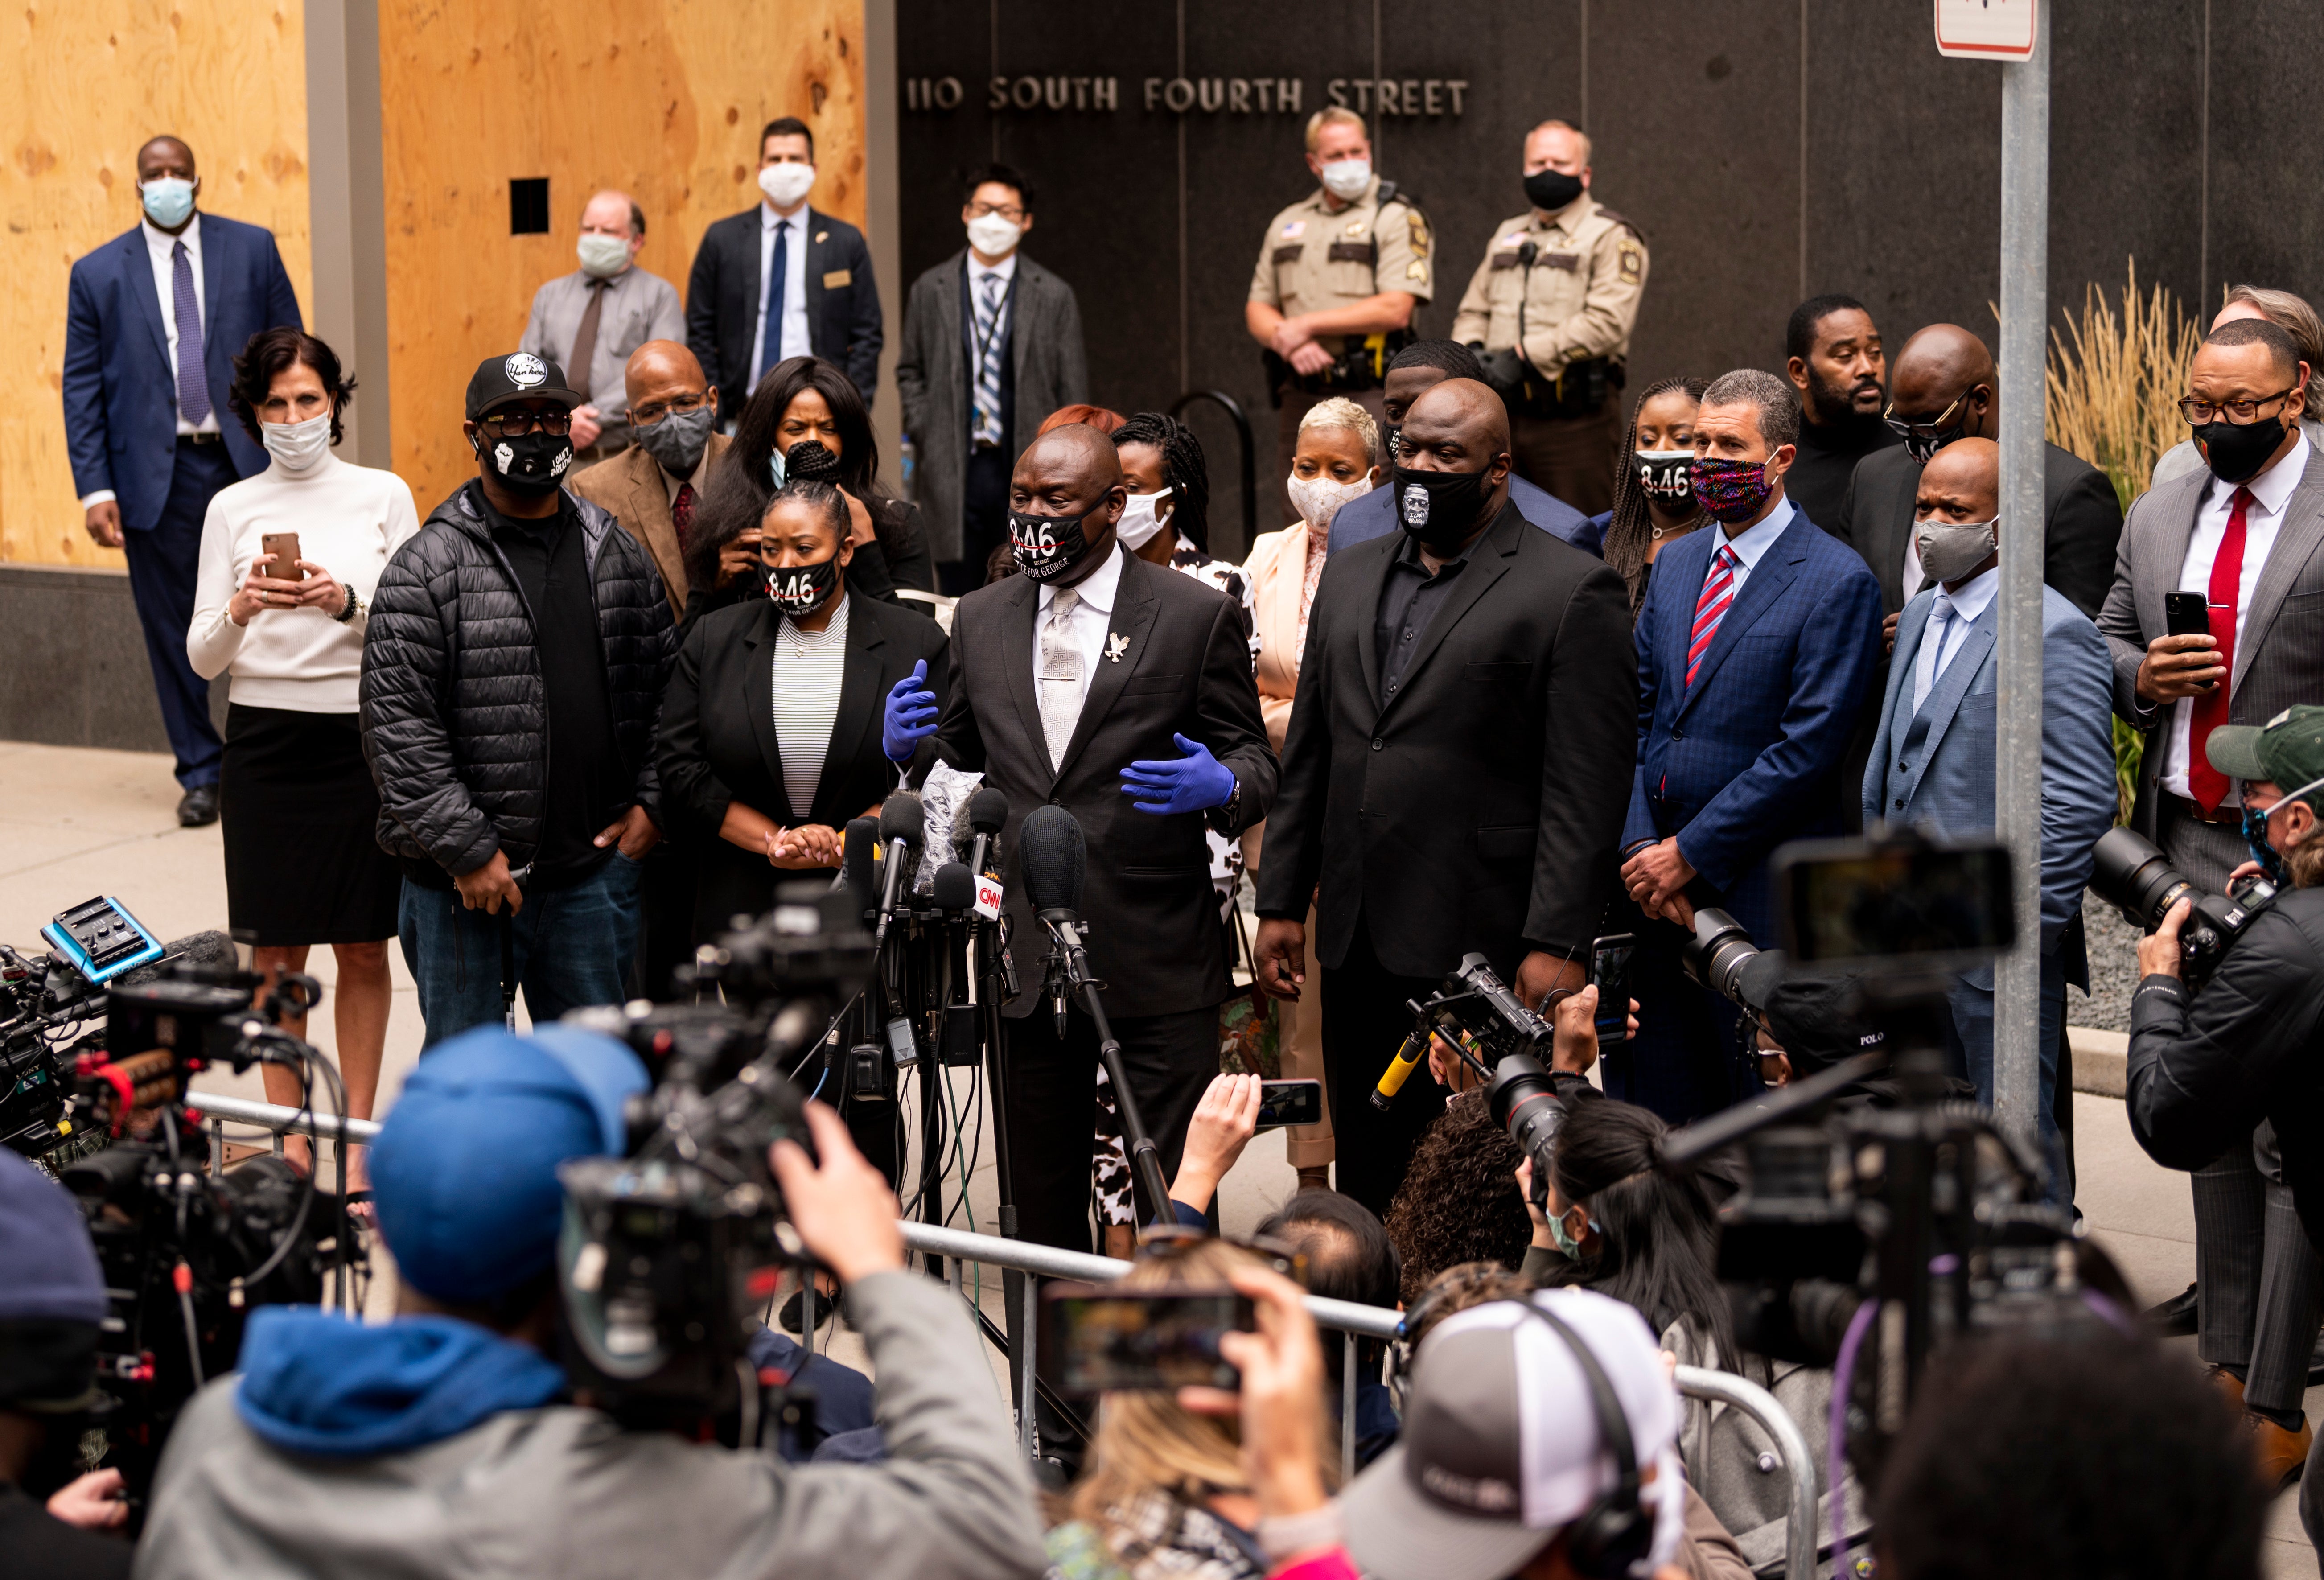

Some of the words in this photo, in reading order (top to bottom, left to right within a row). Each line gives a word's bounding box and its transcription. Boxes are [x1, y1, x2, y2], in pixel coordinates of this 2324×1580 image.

[907, 76, 963, 111] 110
[988, 76, 1118, 111] SOUTH
[1143, 77, 1303, 113] FOURTH
[1327, 78, 1468, 115] STREET
[552, 459, 555, 468] I
[555, 446, 568, 464] CAN'T
[1641, 465, 1688, 498] 8:46
[1010, 518, 1056, 559] 8:46
[1027, 567, 1041, 578] FOR
[1040, 557, 1070, 576] GEORGE
[1033, 557, 1050, 566] SECONDS
[769, 572, 814, 606] 8:46
[979, 887, 1001, 910] CNN
[107, 956, 150, 980] DRACAST
[1410, 1036, 1419, 1045] ikan
[1860, 1032, 1884, 1045] POLO
